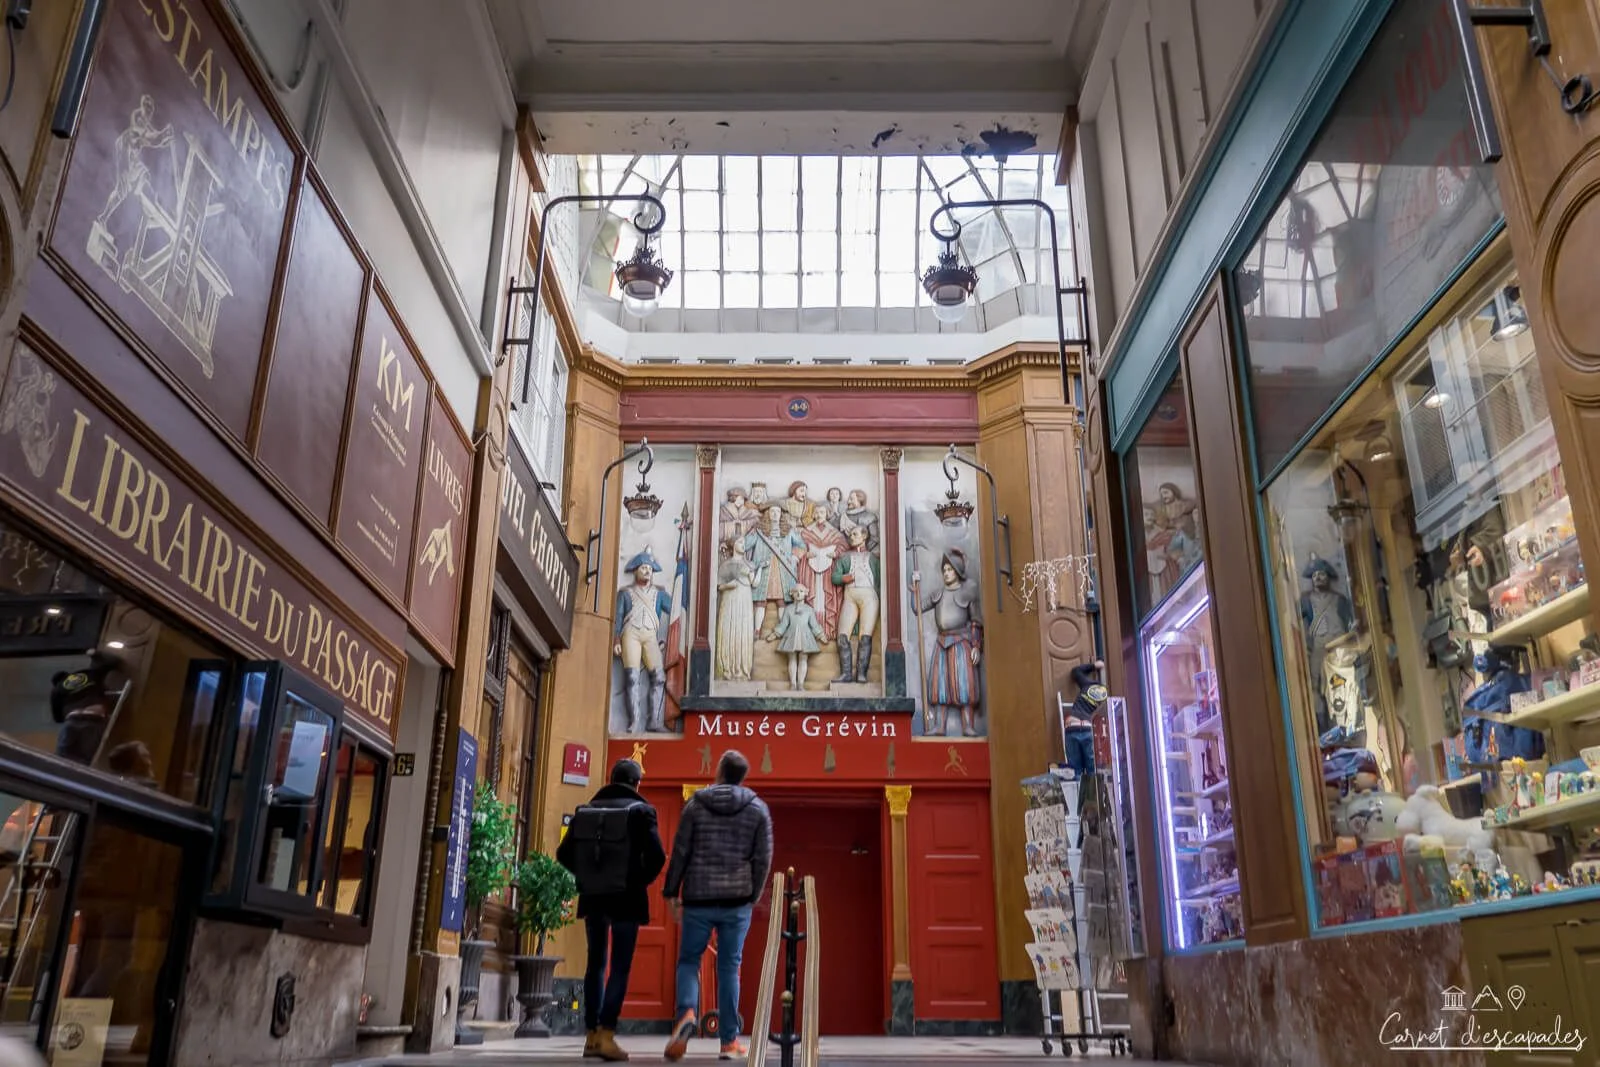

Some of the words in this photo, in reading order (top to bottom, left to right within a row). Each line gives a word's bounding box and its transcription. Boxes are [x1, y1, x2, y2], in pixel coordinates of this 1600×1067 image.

[139, 0, 289, 210] STAMPES
[377, 336, 414, 432] KM
[429, 440, 464, 515] LIVRES
[56, 408, 267, 631] LIBRAIRIE
[264, 588, 304, 657] DU
[301, 604, 397, 725] PASSAGE
[530, 509, 571, 613] CHOPIN
[698, 714, 787, 737] Musée
[801, 715, 897, 738] Grévin
